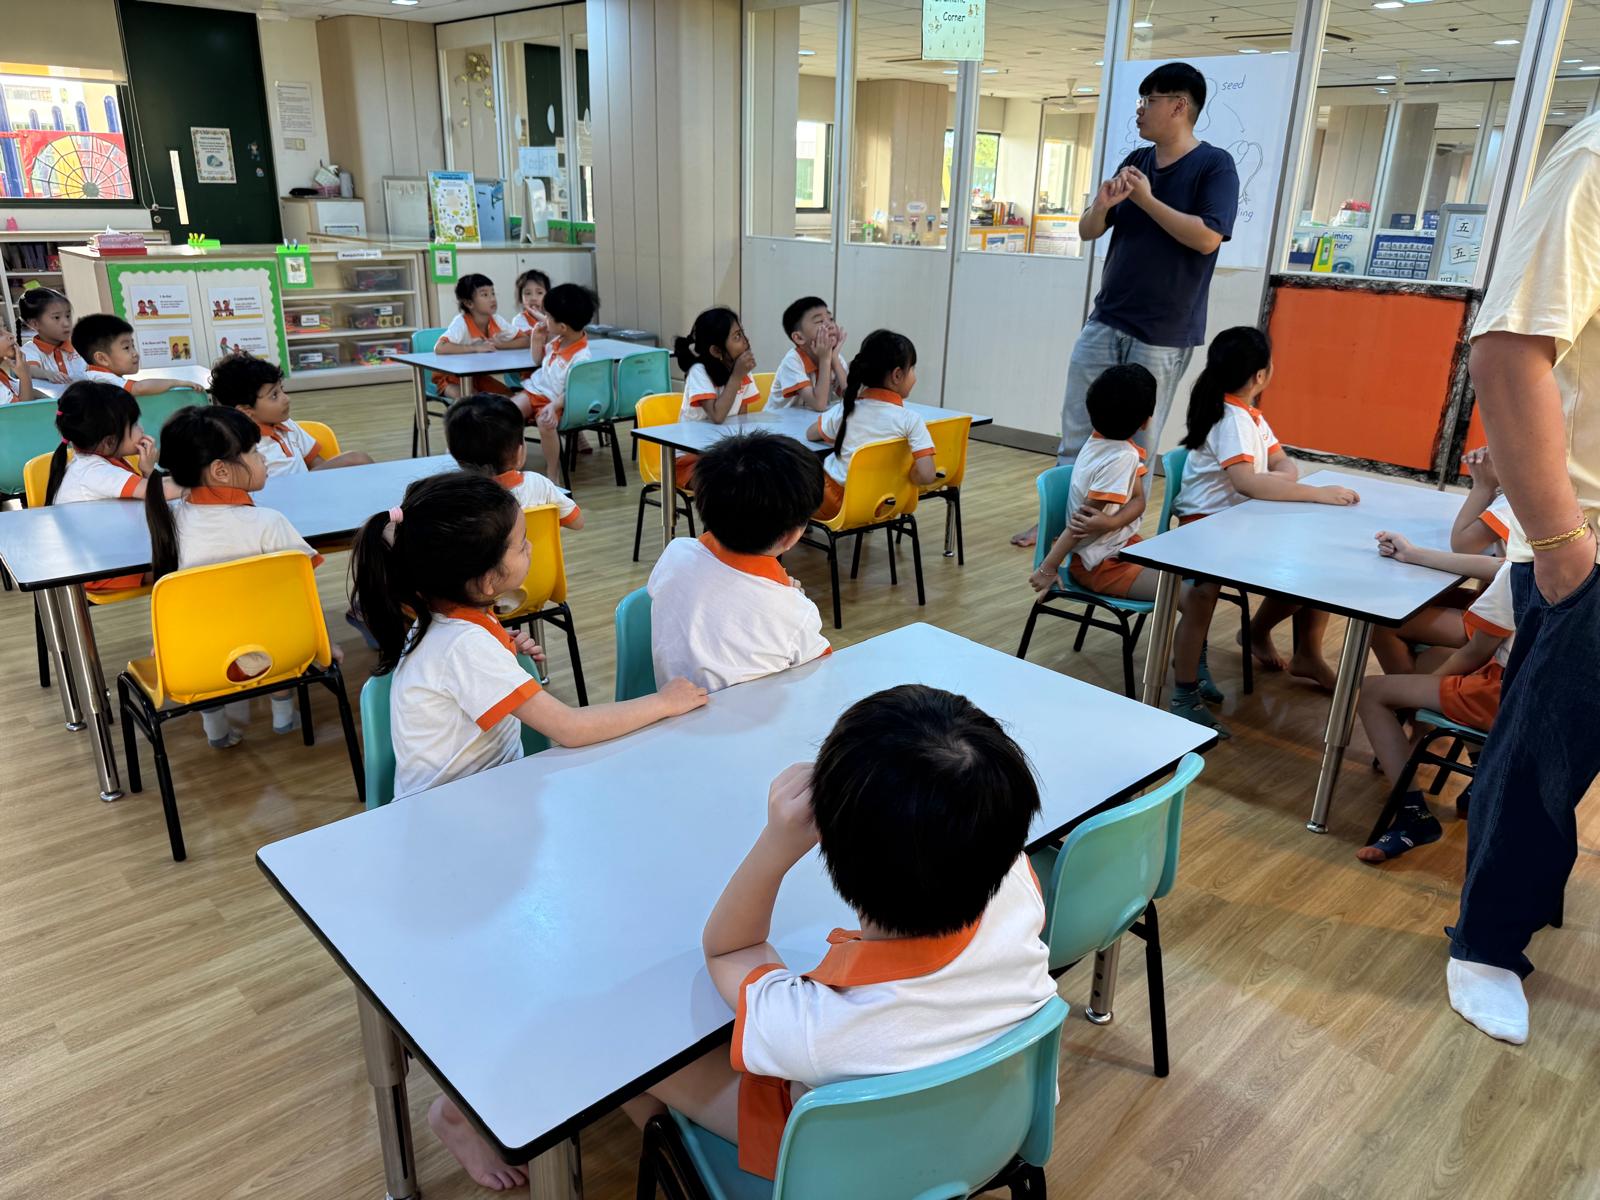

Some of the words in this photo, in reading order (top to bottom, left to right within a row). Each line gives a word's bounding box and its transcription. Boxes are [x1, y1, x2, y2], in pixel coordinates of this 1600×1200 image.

[943, 11, 966, 22] Corner
[1221, 74, 1247, 91] seed
[1456, 222, 1470, 232] 五
[1452, 247, 1466, 260] 五
